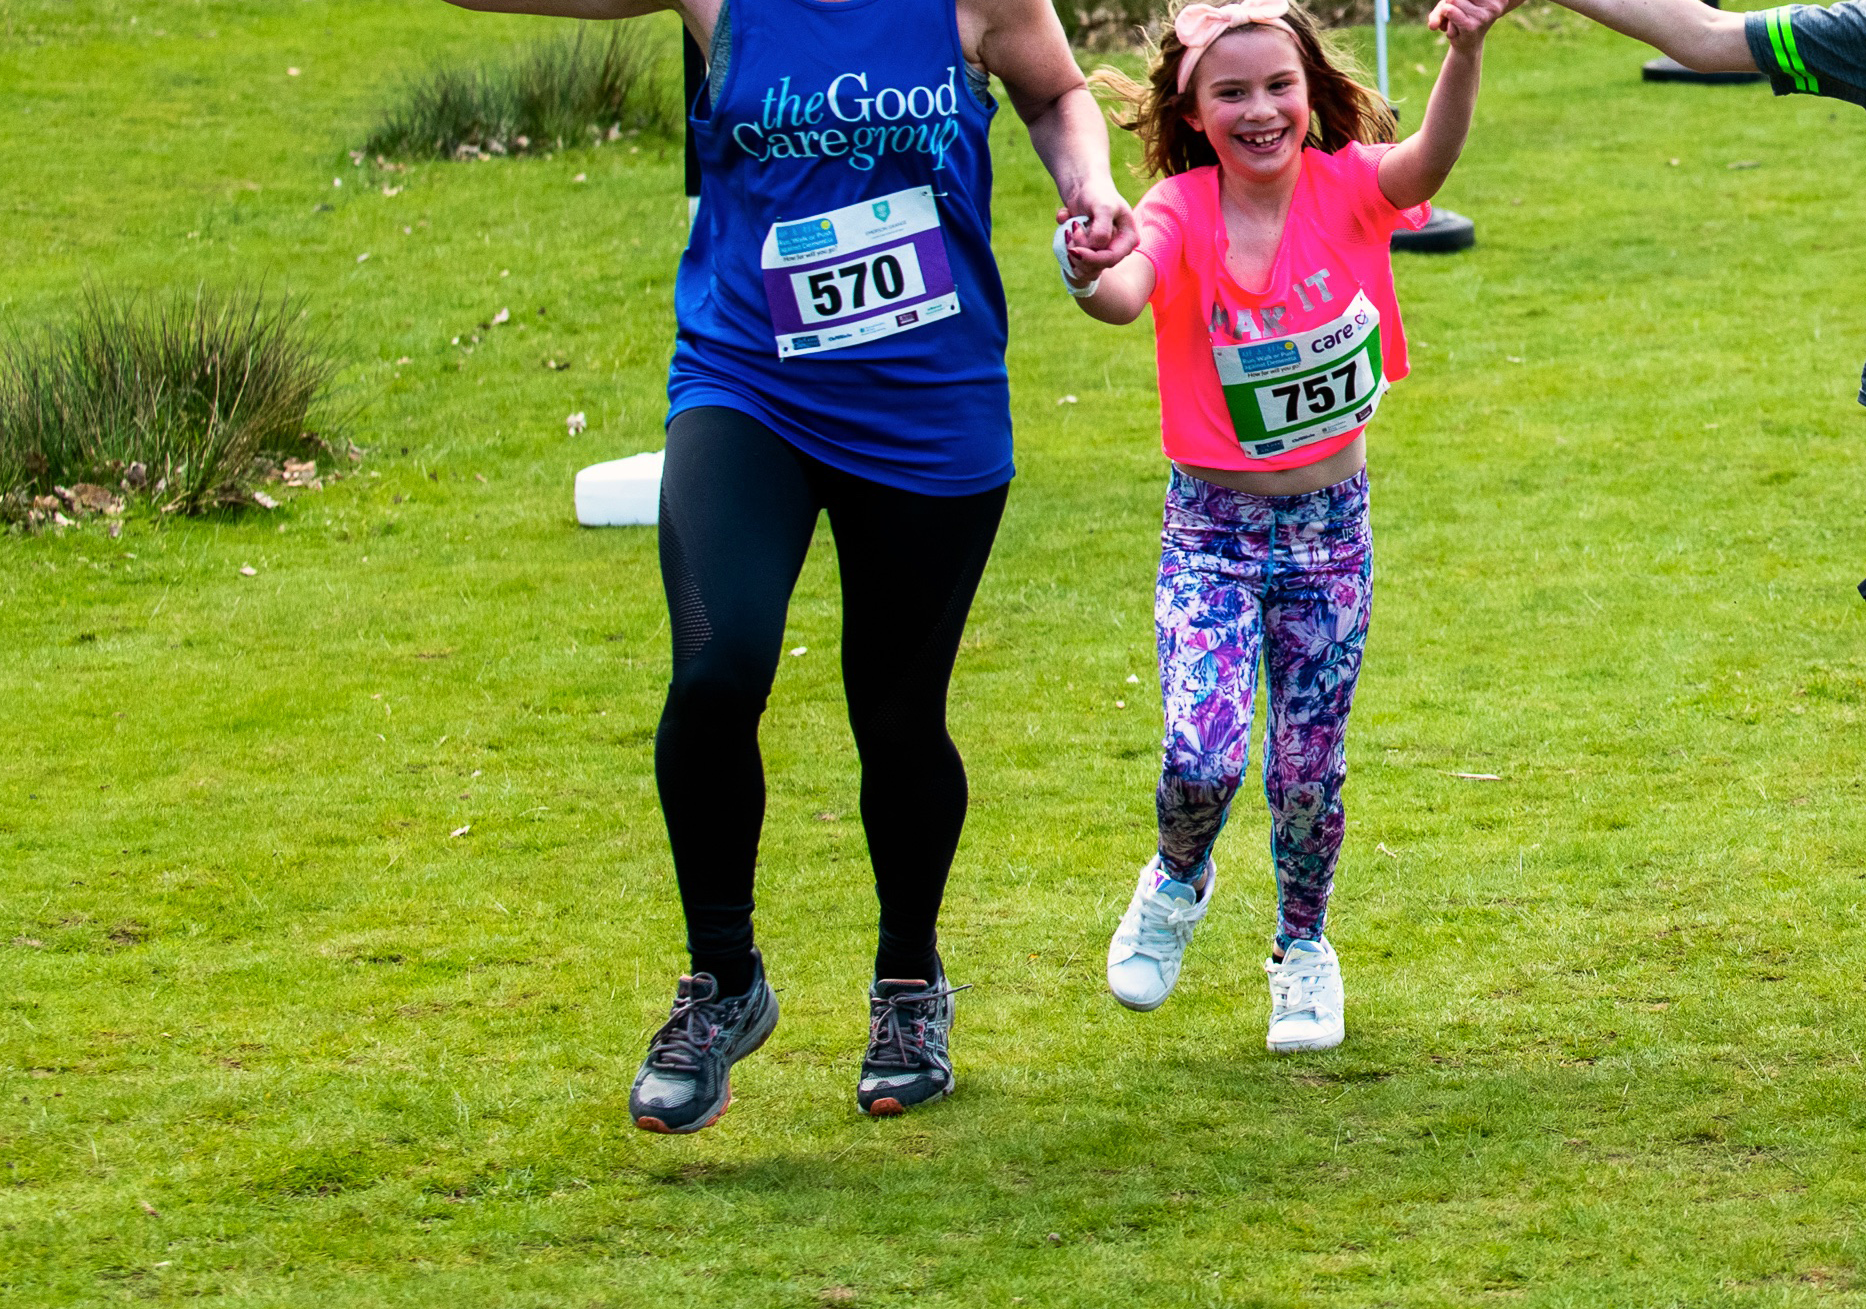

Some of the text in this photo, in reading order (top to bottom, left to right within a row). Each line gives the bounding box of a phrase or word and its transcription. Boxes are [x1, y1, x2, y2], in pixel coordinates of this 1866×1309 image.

[760, 66, 959, 130] the Good
[732, 117, 959, 171] Care group
[808, 254, 905, 316] 570
[1292, 268, 1334, 312] IT
[1311, 324, 1354, 353] care
[1272, 360, 1357, 423] 757
